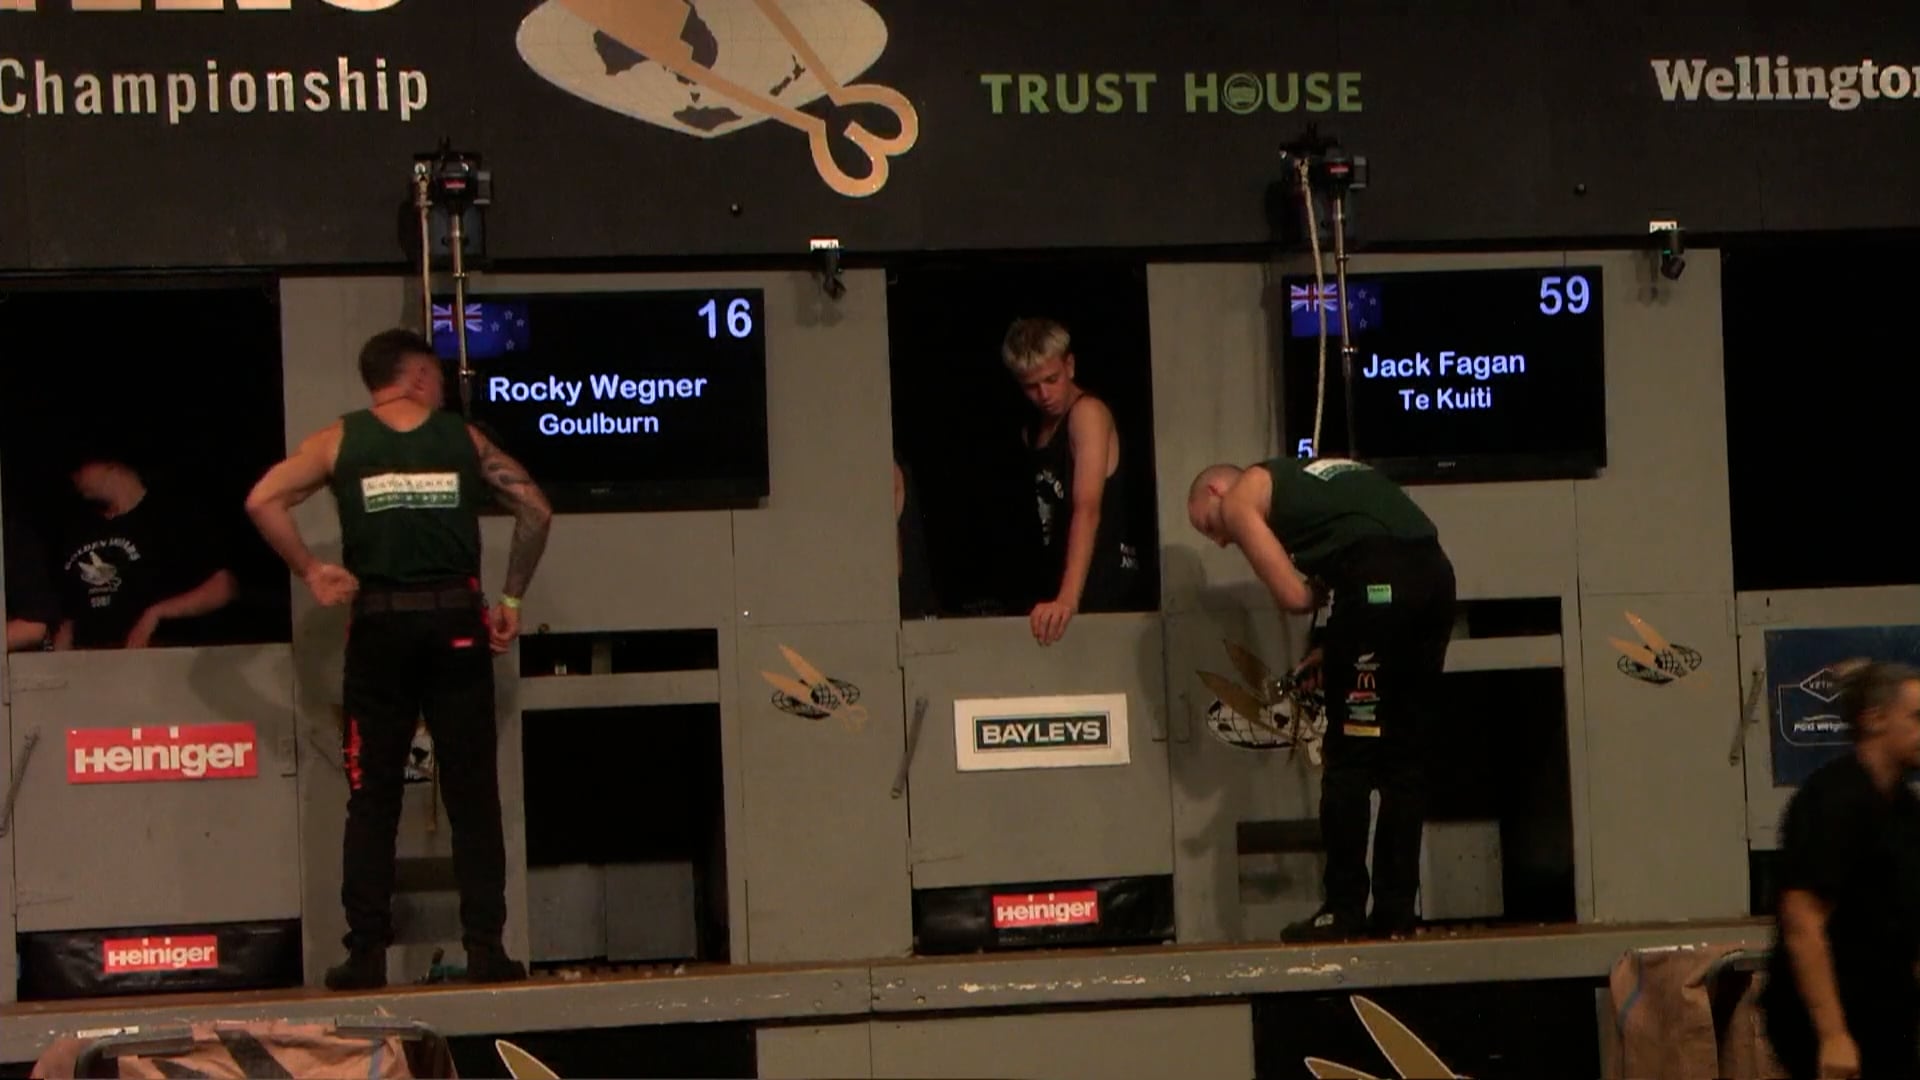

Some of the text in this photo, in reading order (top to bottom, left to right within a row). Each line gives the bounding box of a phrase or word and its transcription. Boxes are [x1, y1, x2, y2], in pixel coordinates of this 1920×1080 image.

[0, 56, 427, 124] Championship
[981, 72, 1363, 115] TRUST HOUSE
[1651, 55, 1920, 110] Wellingto
[1540, 275, 1590, 315] 59
[698, 298, 753, 339] 16
[1363, 351, 1525, 380] Jack Fagan
[489, 374, 707, 406] Rocky Wegner
[1399, 387, 1492, 411] Te Kuiti
[538, 413, 659, 436] Goulburn
[981, 721, 1101, 745] BAYLEYS
[74, 726, 253, 778] Heiniger
[997, 893, 1095, 922] Heiniger
[108, 937, 215, 967] Heiniger
